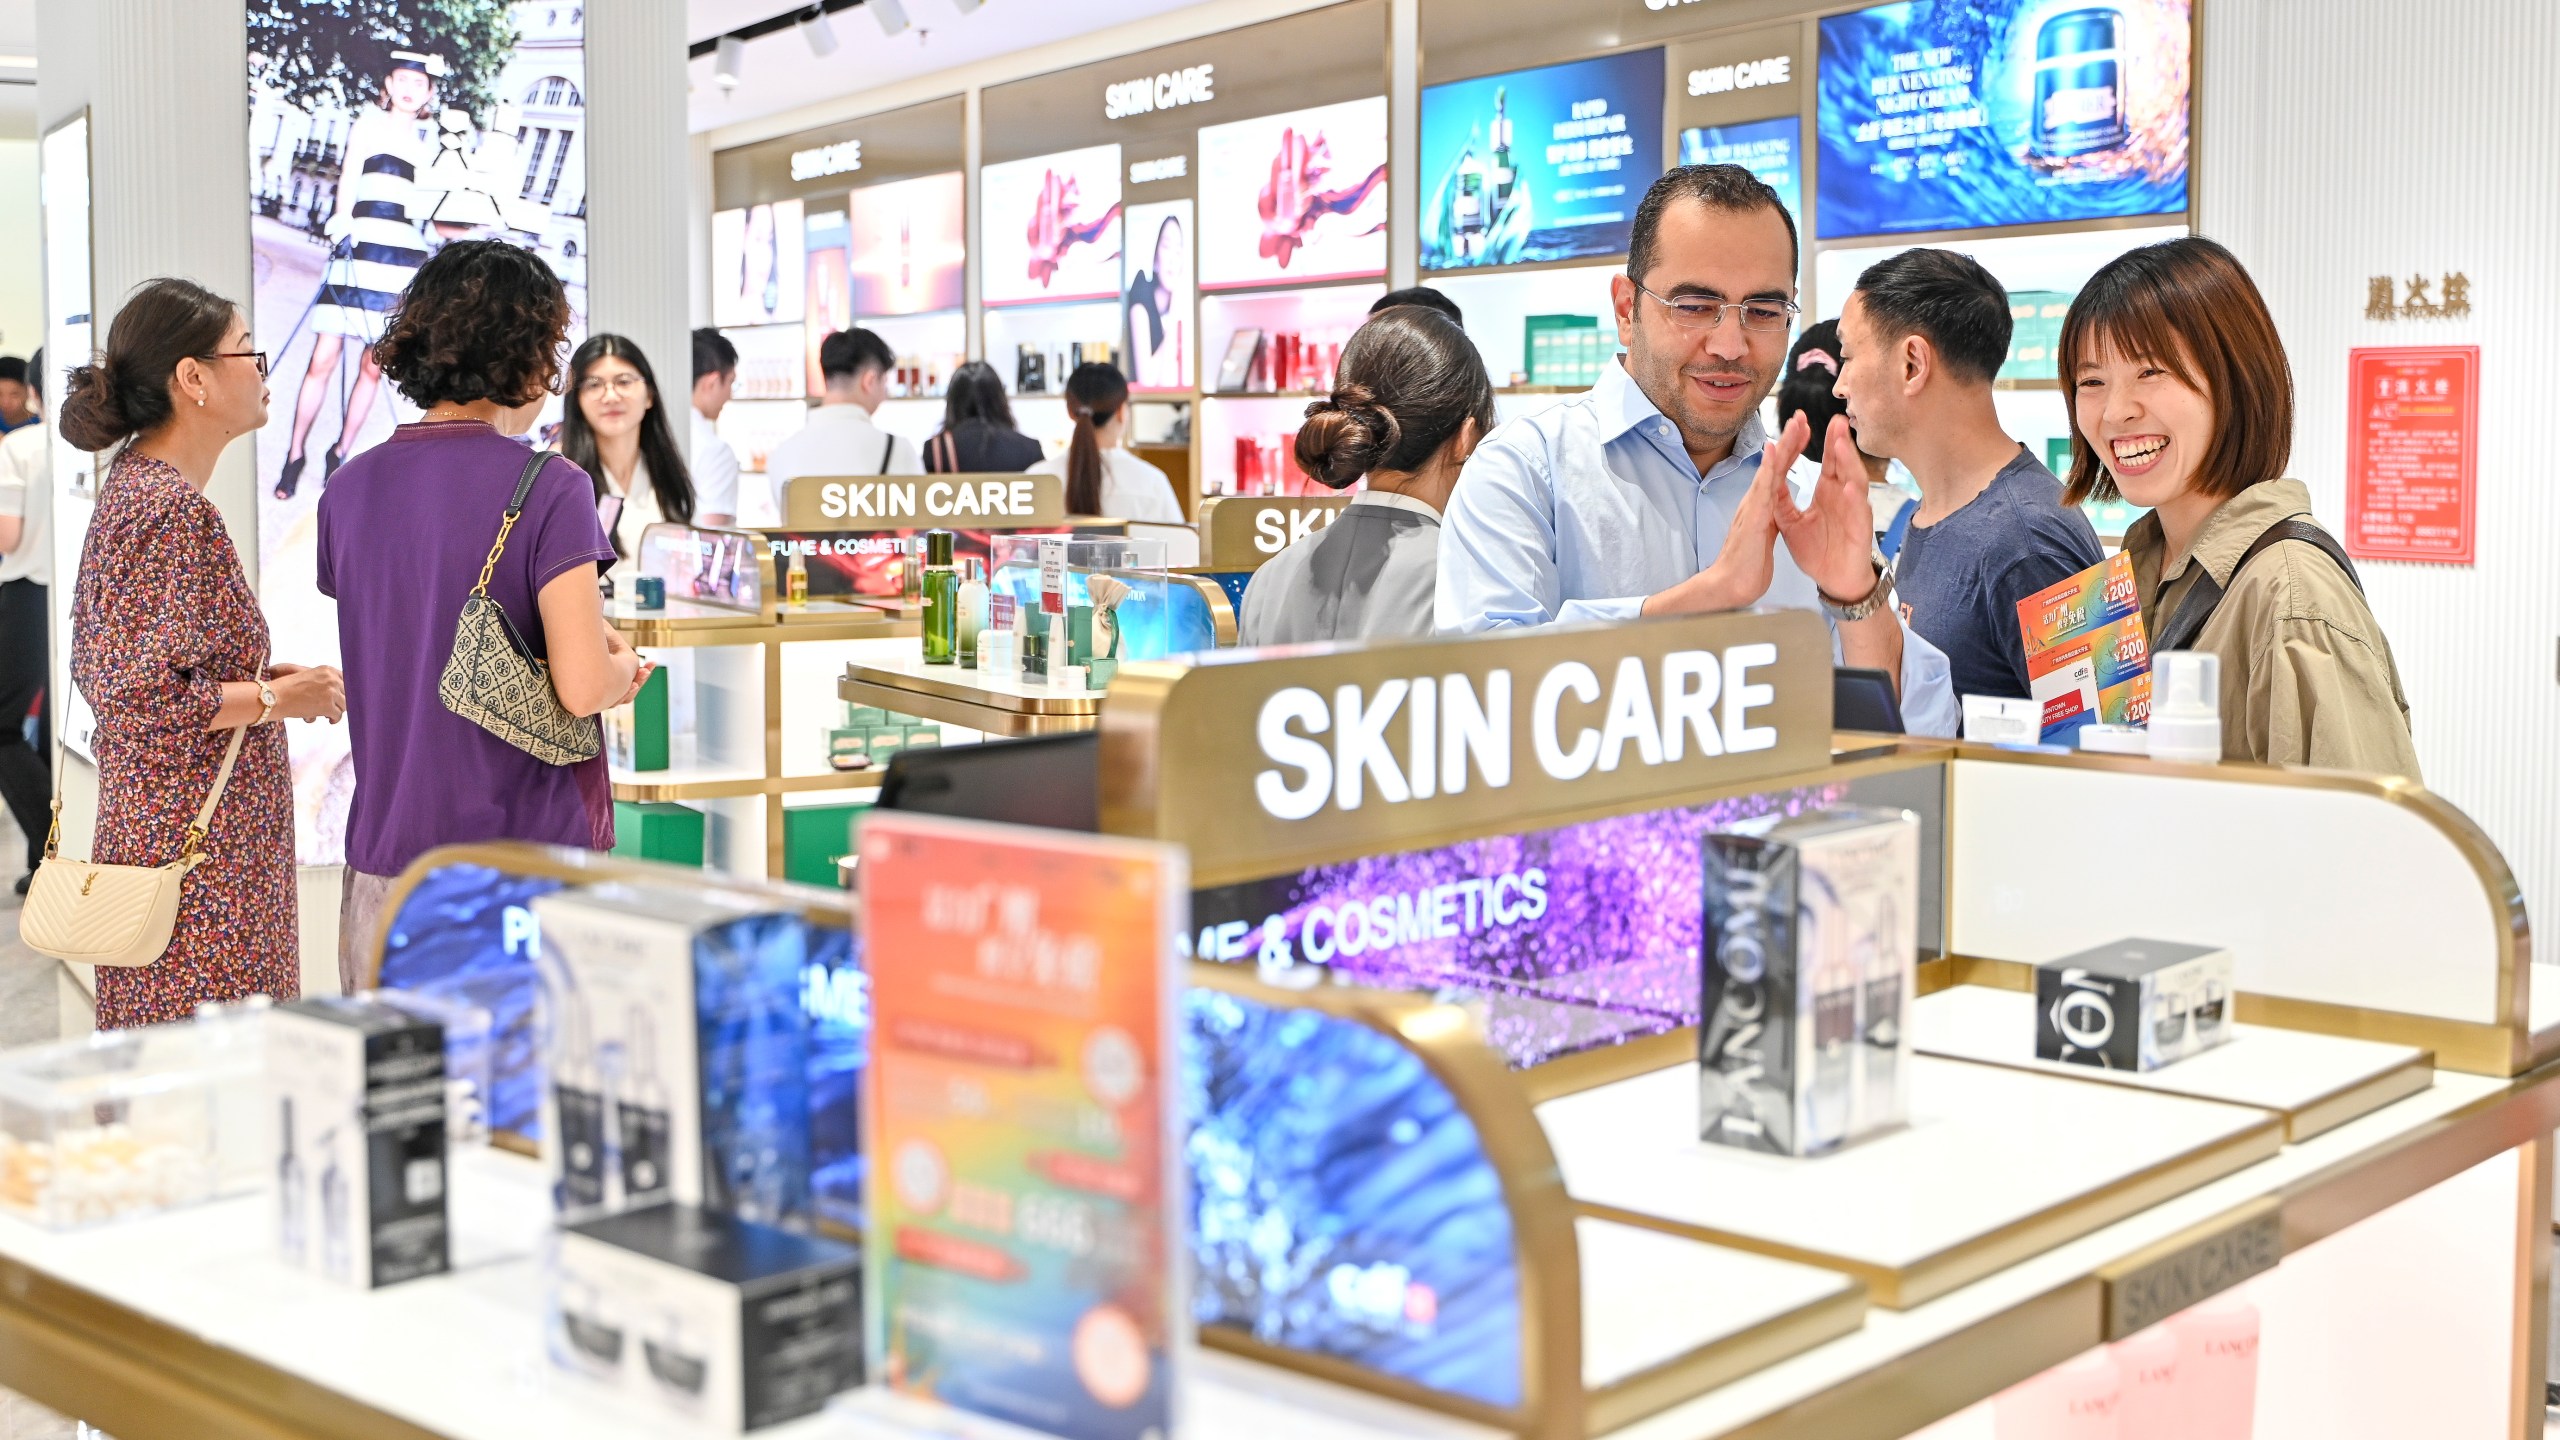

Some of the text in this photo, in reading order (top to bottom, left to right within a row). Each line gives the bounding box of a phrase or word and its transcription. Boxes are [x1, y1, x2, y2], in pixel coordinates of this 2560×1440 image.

[1105, 64, 1213, 119] SKIN CARE
[1688, 55, 1791, 96] SKIN CARE
[820, 481, 1034, 518] SKIN CARE
[834, 537, 928, 556] COSMETIS
[2103, 578, 2134, 604] ¥200
[2113, 638, 2145, 663] ¥200
[2042, 701, 2067, 715] WNTOWN
[2052, 710, 2065, 720] FREE
[2065, 704, 2079, 715] SHOP
[1256, 642, 1777, 820] SKIN CARE
[1302, 867, 1548, 965] COSMETICS
[2125, 1219, 2273, 1327] SKIN CARE
